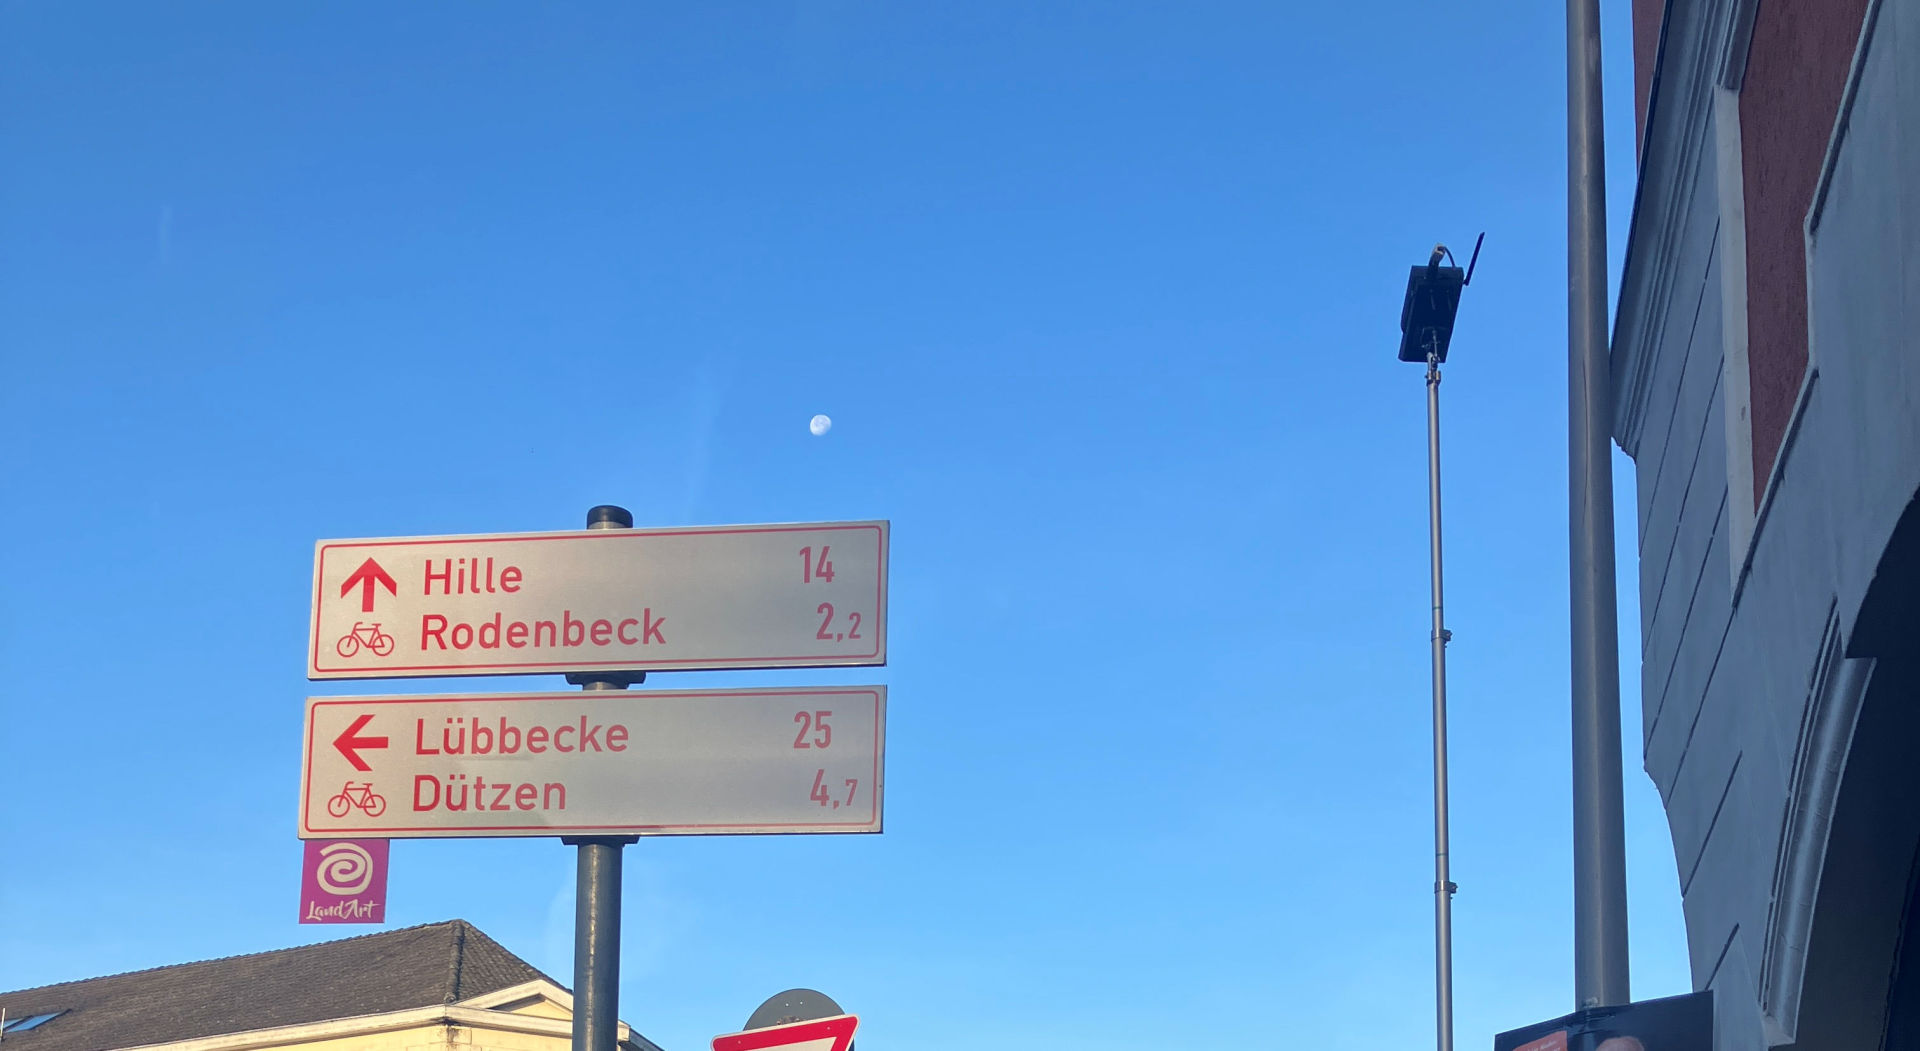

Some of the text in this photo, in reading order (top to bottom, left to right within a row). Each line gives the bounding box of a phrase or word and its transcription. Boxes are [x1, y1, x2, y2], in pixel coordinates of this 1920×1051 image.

[422, 546, 836, 597] Hille 14
[420, 602, 862, 653] Rodenbeck 2,2
[415, 711, 834, 757] Lübbecke 25
[412, 768, 858, 814] Dützen 4,7
[305, 899, 382, 921] LandArt
